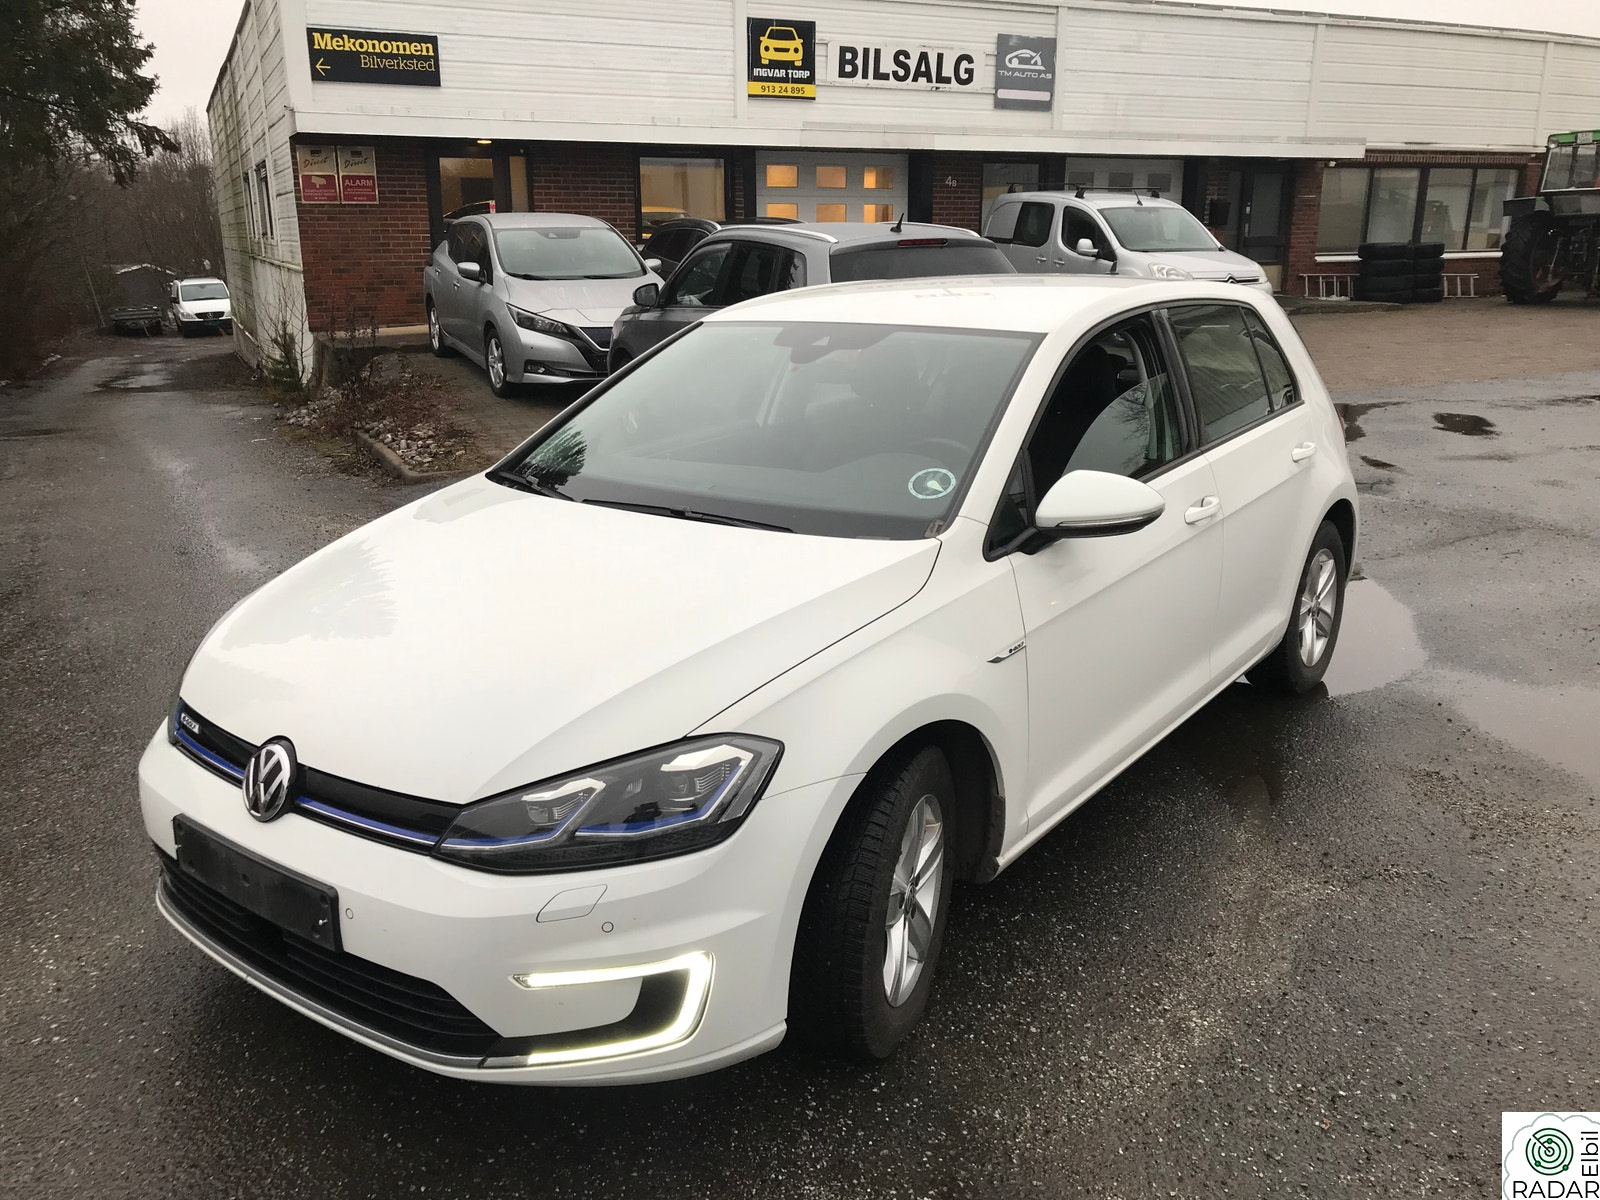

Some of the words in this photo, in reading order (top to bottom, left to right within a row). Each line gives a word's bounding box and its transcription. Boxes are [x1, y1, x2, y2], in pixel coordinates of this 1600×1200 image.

[312, 32, 434, 56] Mekonomen
[360, 54, 436, 72] Bilverksted
[838, 45, 975, 86] BILSALG
[753, 67, 786, 78] INGVAR
[787, 69, 810, 79] TORP
[761, 85, 776, 93] 913
[778, 85, 788, 94] 24
[790, 86, 805, 95] 895
[344, 179, 373, 187] ALARM
